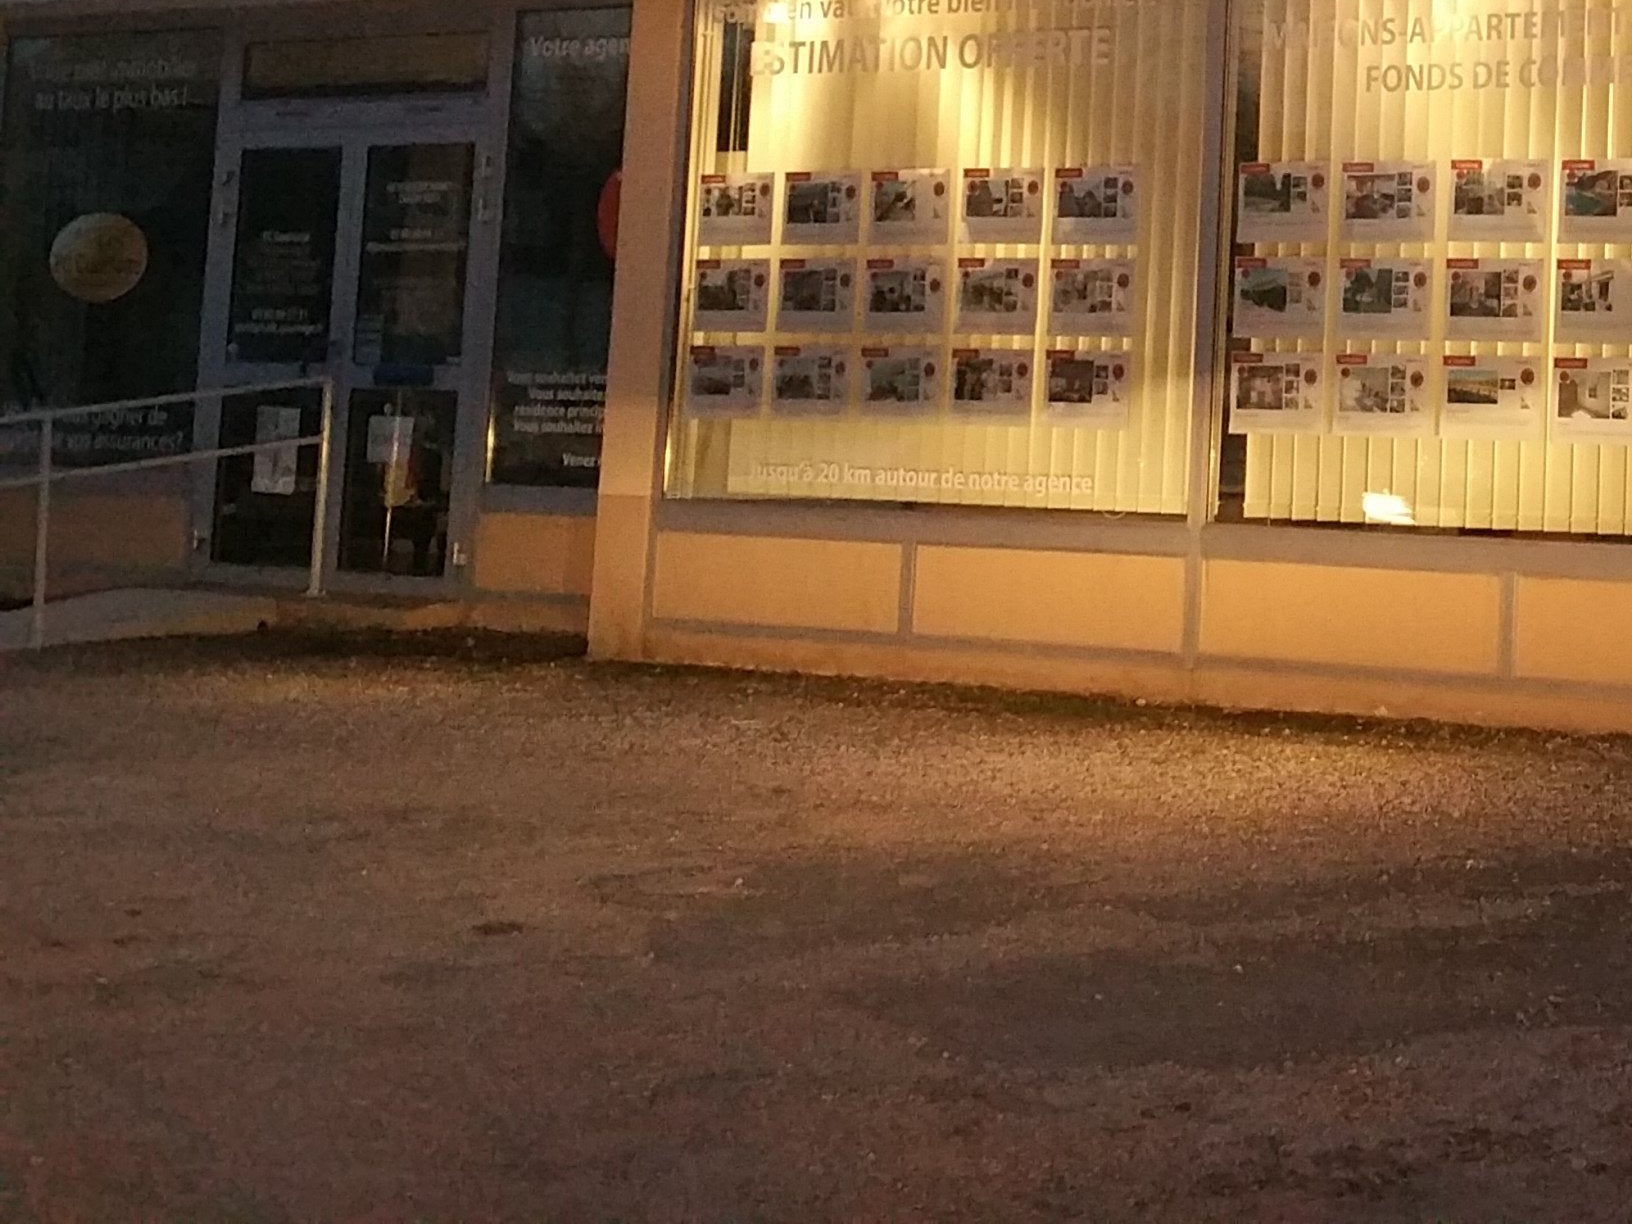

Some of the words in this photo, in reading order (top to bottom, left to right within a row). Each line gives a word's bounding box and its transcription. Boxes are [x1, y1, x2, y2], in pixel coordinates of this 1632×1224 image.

[584, 38, 631, 64] agen
[750, 36, 950, 78] ESTIMATION
[1364, 63, 1464, 93] FONDS
[1472, 60, 1511, 89] DE
[817, 463, 840, 483] 20
[845, 462, 872, 485] km
[875, 466, 939, 487] autour
[941, 466, 965, 488] de
[968, 470, 1019, 492] notre
[1023, 474, 1093, 498] agence
